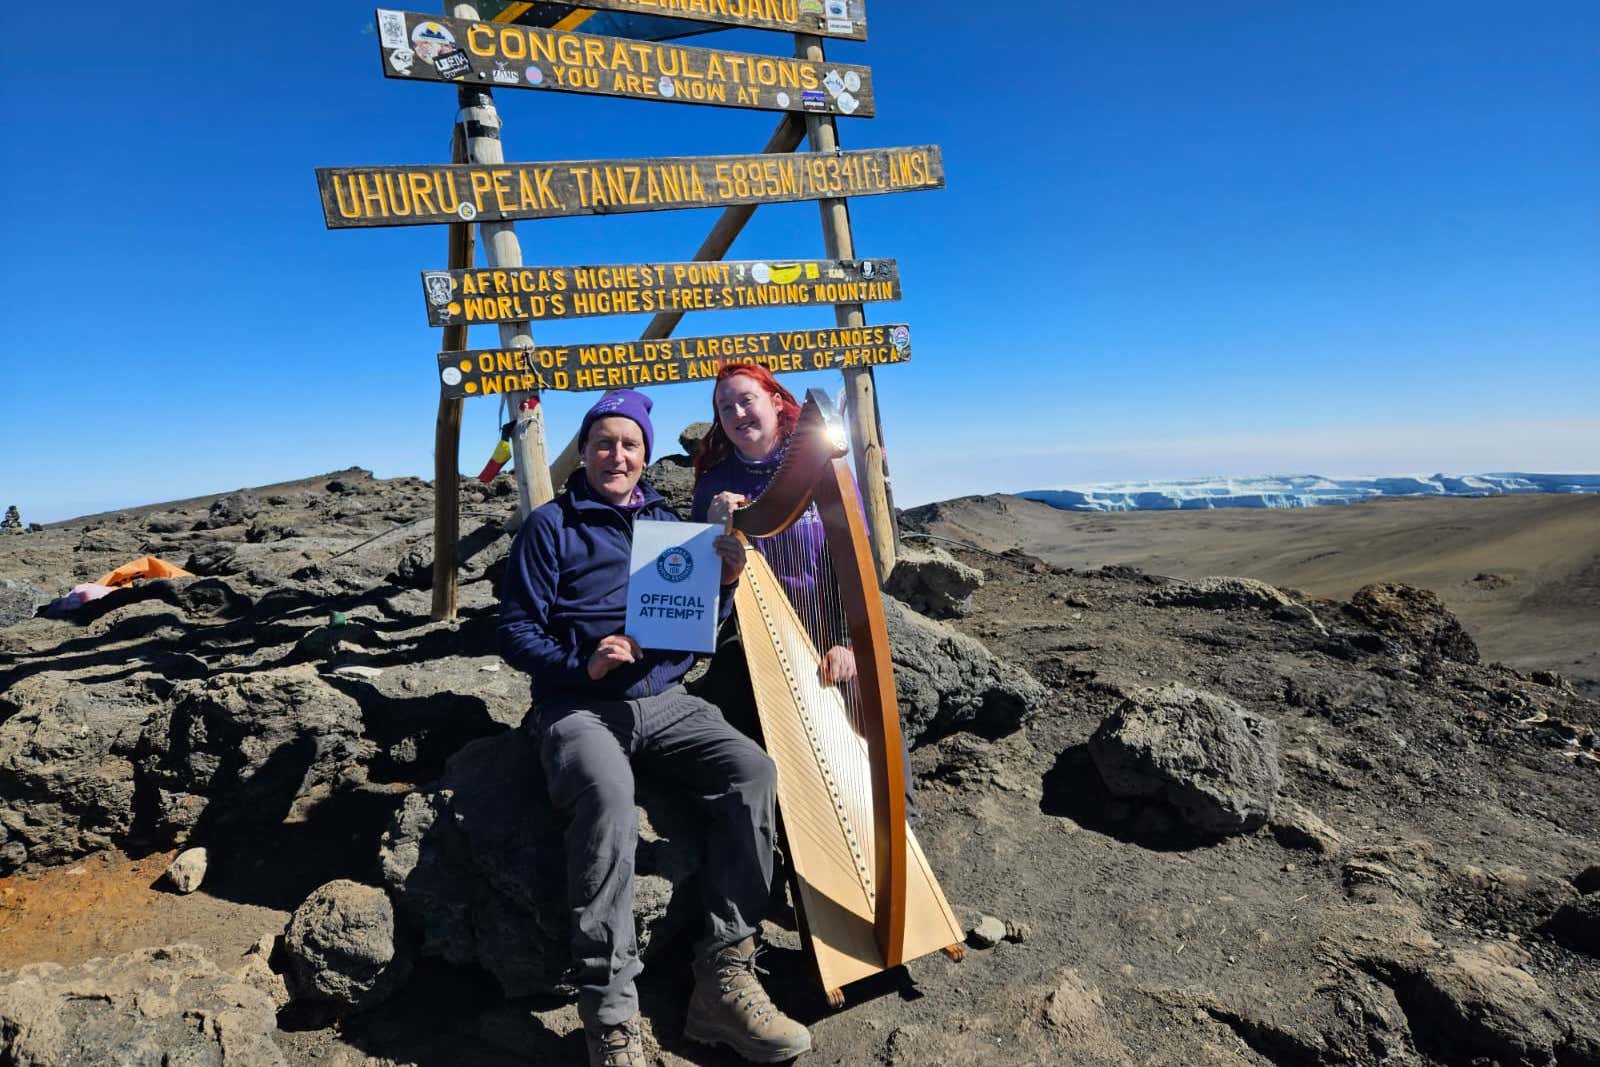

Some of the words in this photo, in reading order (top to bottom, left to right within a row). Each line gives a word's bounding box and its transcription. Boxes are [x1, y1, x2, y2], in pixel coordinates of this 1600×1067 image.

[467, 24, 820, 89] CONGRATULATIONS
[554, 66, 600, 88] YOU
[613, 76, 657, 96] ARE
[673, 81, 725, 102] NOW
[737, 87, 760, 106] AT
[333, 171, 459, 218] UHURU
[470, 167, 566, 213] PEAK,
[570, 163, 712, 208] TANZANIA,
[889, 152, 937, 186] AMSL
[462, 269, 567, 295] AFRICA'S
[574, 265, 665, 290] HIGHEST
[673, 263, 731, 286] POINT
[465, 294, 566, 320] WORLD'S
[573, 289, 666, 314] HIGHEST
[814, 281, 894, 302] MOUNTAIN
[478, 349, 533, 373] ONE
[538, 348, 569, 369] OF
[579, 341, 673, 365] WORLD'S
[681, 336, 770, 358] LARGEST
[778, 328, 885, 351] VOLCANOES
[577, 364, 680, 387] HERITAGE
[687, 361, 721, 379] AND
[813, 351, 835, 369] OF
[843, 346, 899, 366] AFRICA
[639, 607, 704, 620] ATTEMPT
[640, 594, 704, 607] OFFICIAL
